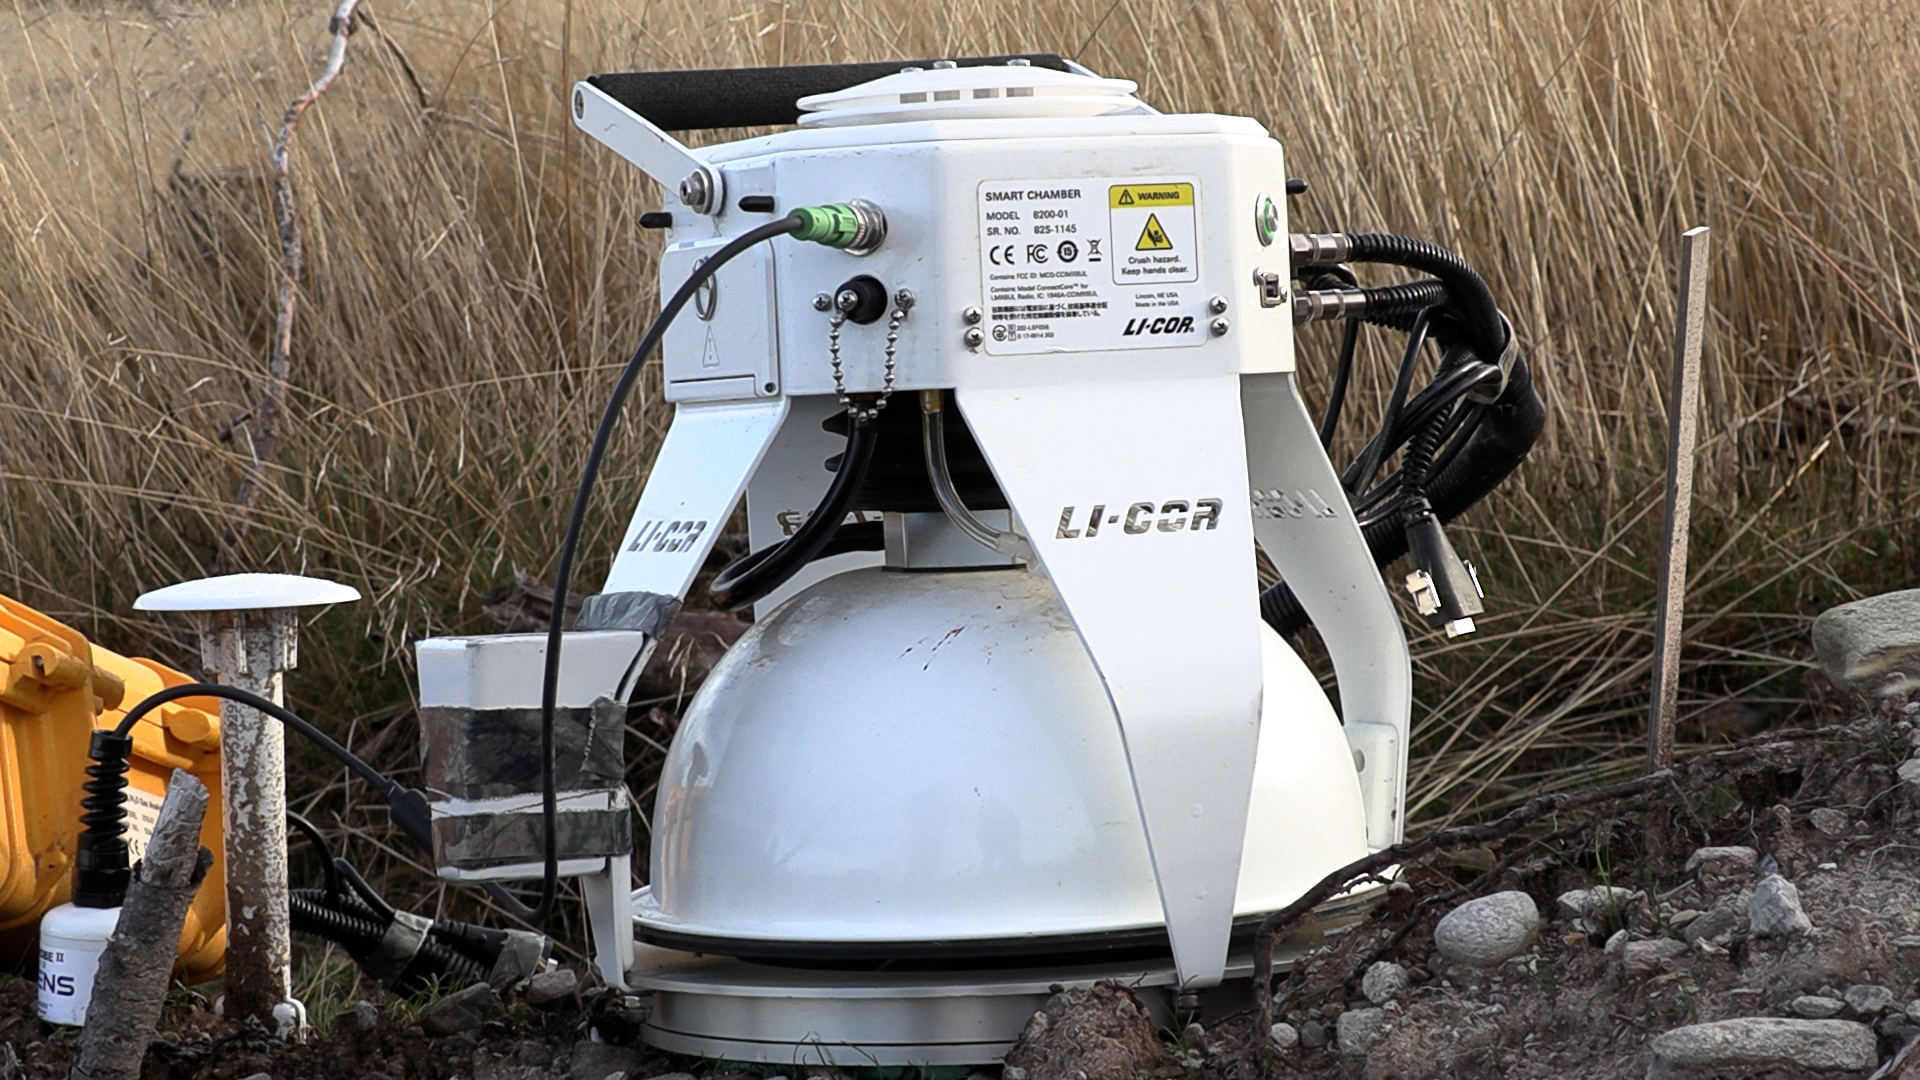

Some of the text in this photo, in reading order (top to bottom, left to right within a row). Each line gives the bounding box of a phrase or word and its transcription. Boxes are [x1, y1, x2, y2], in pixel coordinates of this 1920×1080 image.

[985, 189, 1081, 201] SMART CHAMBER
[1137, 191, 1180, 201] WARNING
[986, 211, 1020, 221] MODEL
[987, 226, 1002, 236] SR.
[1004, 226, 1021, 236] NO.
[1128, 254, 1181, 265] Crush hazard.
[1121, 265, 1189, 276] Keep hands clear.
[1016, 272, 1029, 280] FCC
[990, 285, 1016, 293] Contains
[1017, 284, 1036, 292] Model
[1080, 282, 1089, 290] for
[1165, 291, 1179, 299] USA
[1167, 299, 1180, 307] USA
[1055, 497, 1223, 540] LI-COR
[627, 520, 708, 553] LI-COR
